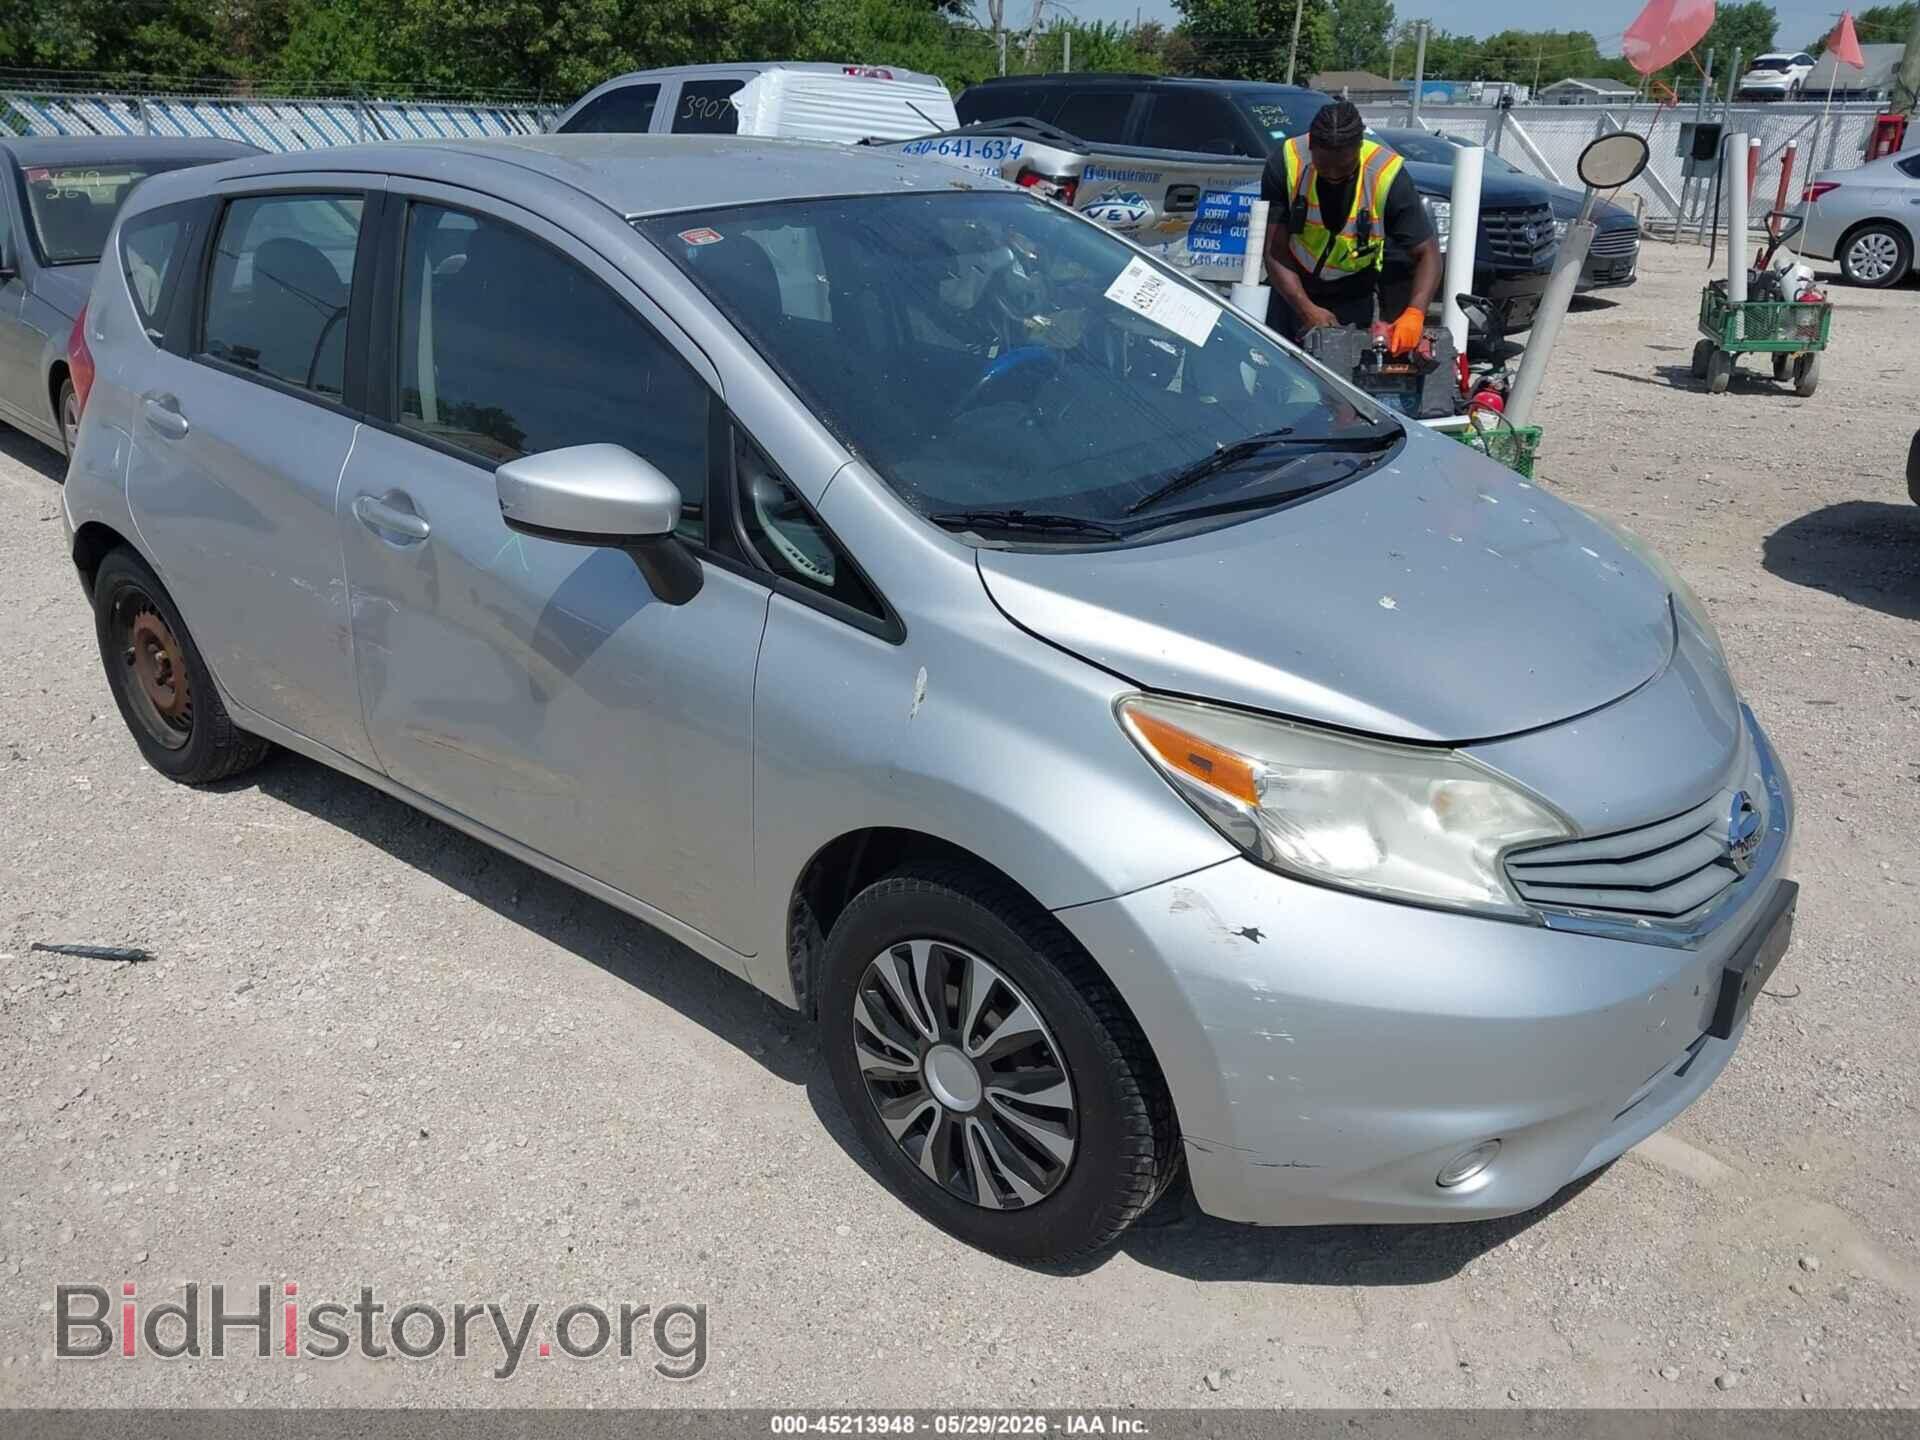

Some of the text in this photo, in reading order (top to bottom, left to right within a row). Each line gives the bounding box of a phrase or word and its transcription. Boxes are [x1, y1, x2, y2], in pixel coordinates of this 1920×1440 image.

[681, 95, 730, 120] 3907
[1086, 209, 1105, 219] V
[1128, 209, 1147, 221] V
[1204, 208, 1230, 219] SOFFIT
[1193, 238, 1221, 250] DOORS
